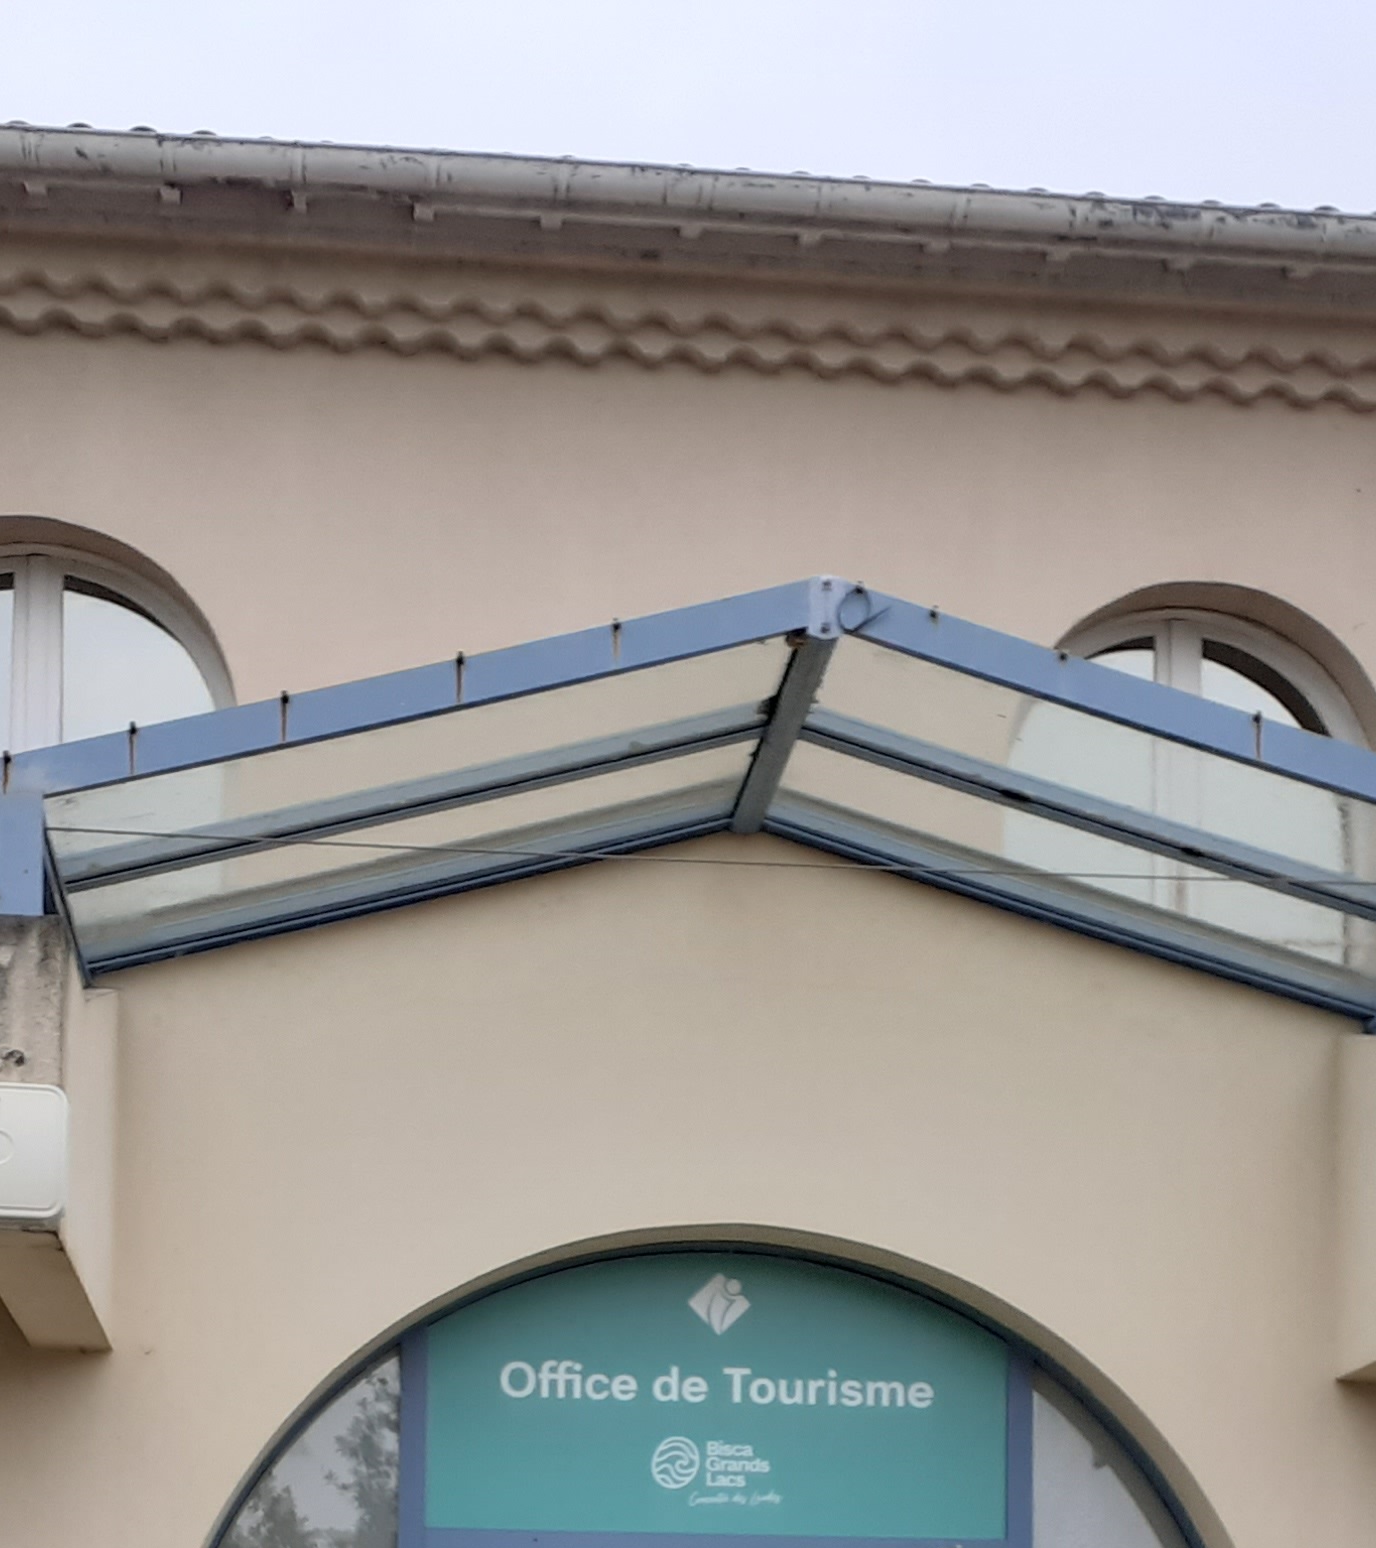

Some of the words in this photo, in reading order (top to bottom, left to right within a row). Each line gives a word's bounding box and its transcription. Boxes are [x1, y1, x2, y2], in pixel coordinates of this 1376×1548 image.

[500, 1360, 638, 1401] Office
[652, 1366, 709, 1402] de
[723, 1367, 935, 1409] Tourisme
[706, 1440, 754, 1457] Bisca
[705, 1457, 771, 1473] Grands
[706, 1472, 747, 1487] Lacs
